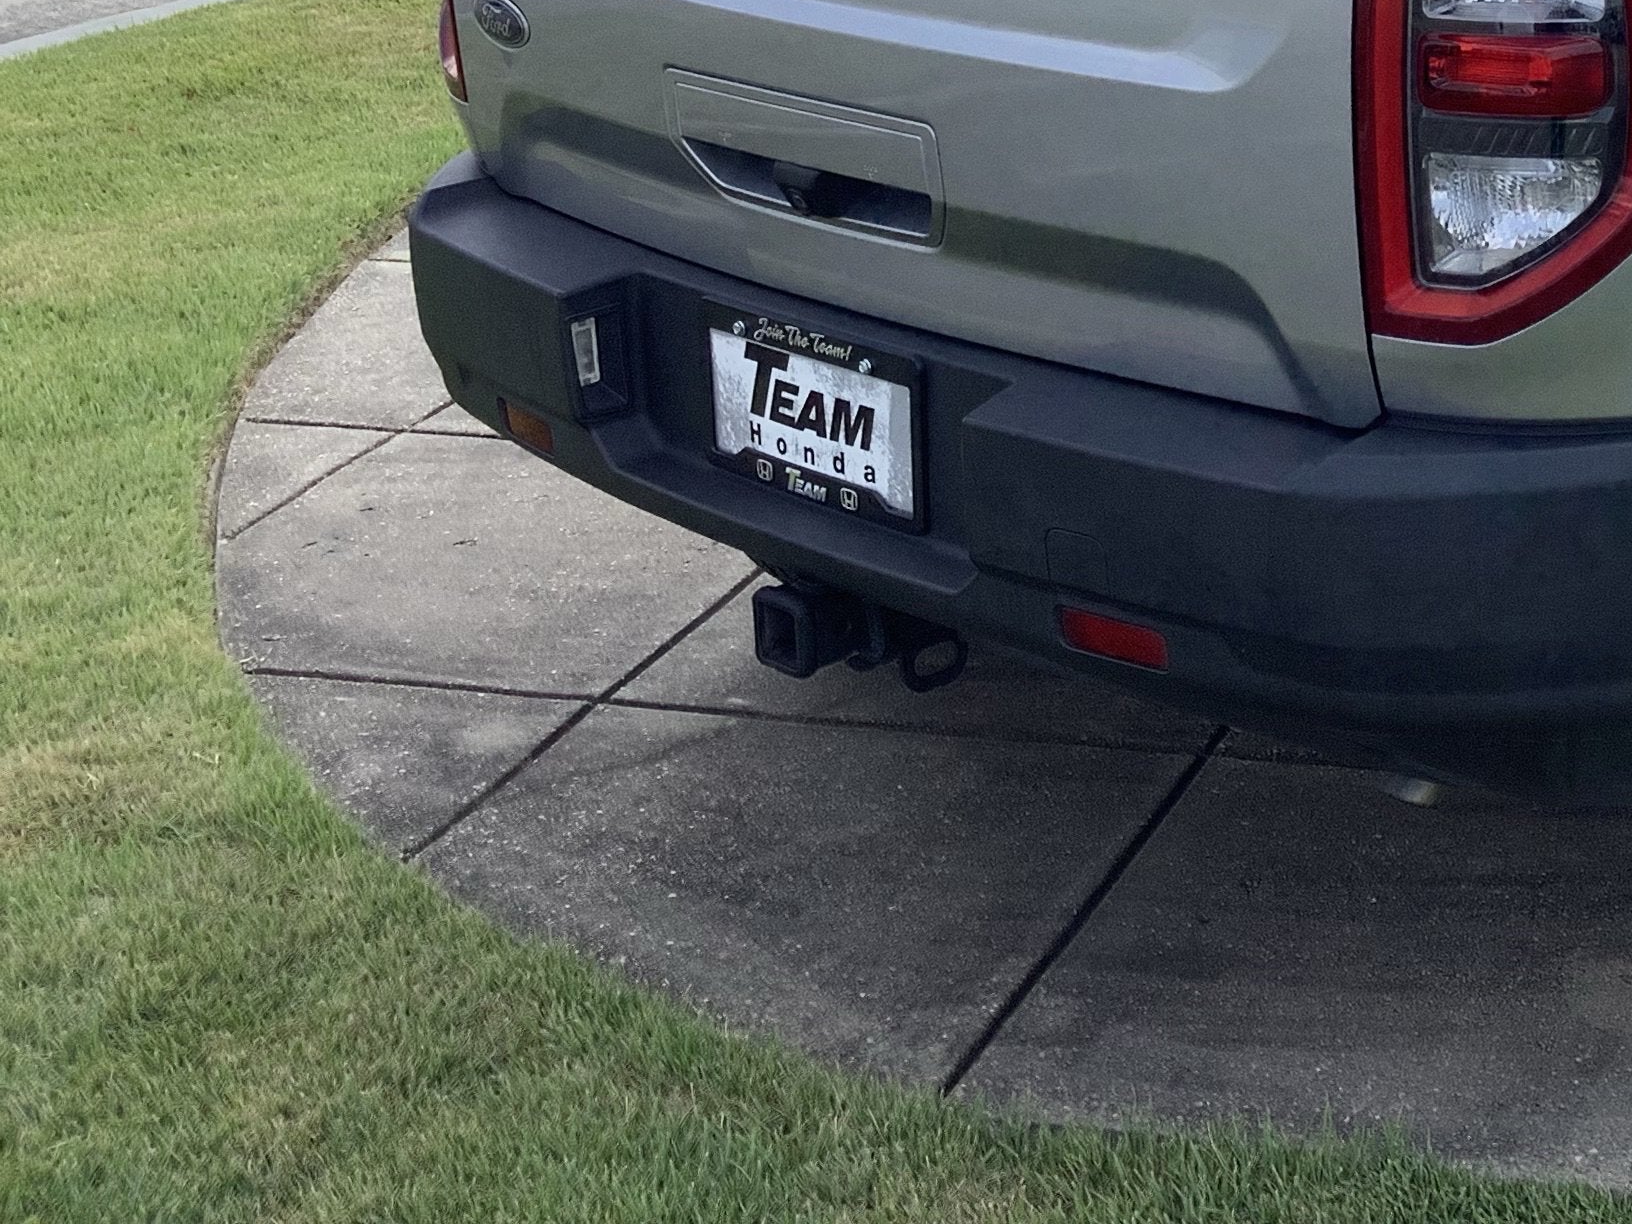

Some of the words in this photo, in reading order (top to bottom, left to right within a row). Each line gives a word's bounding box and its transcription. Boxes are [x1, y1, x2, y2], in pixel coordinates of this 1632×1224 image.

[753, 318, 785, 341] Join
[784, 325, 810, 348] The
[809, 332, 853, 361] Team!
[744, 342, 875, 452] TEAM
[749, 420, 876, 484] Honda
[785, 467, 827, 502] TEAM
